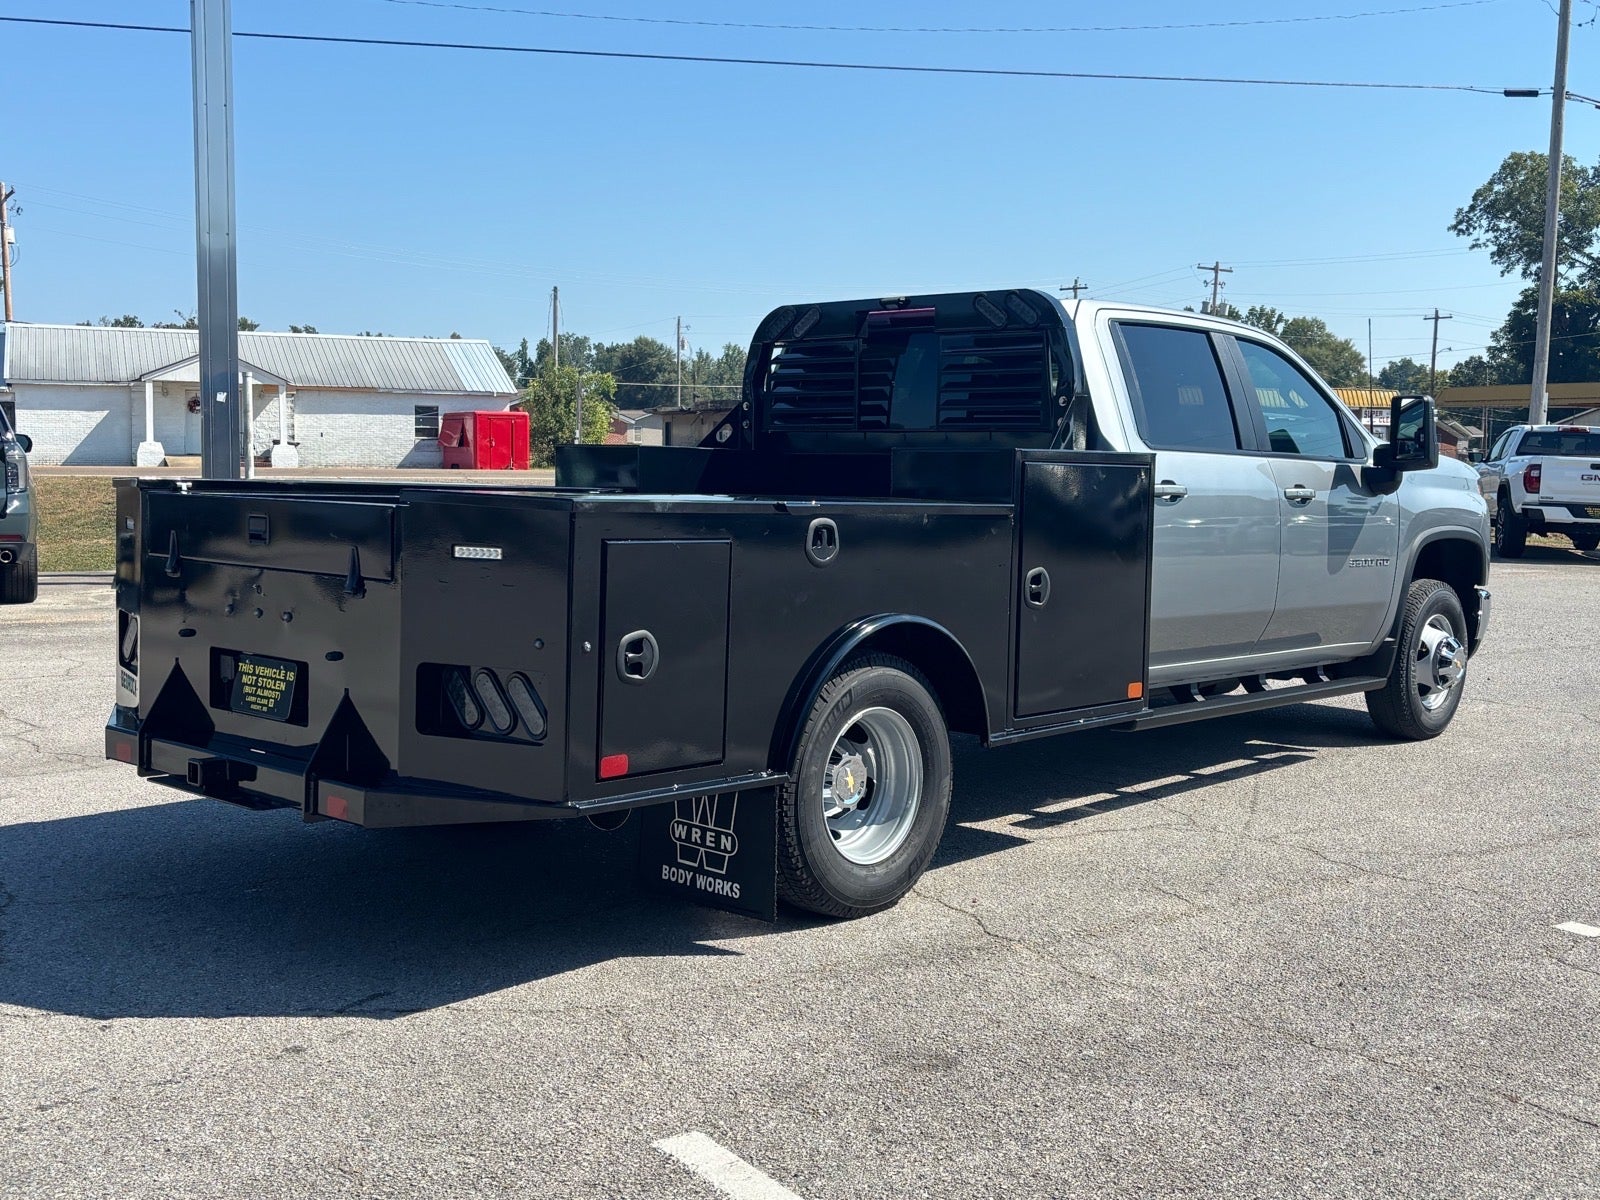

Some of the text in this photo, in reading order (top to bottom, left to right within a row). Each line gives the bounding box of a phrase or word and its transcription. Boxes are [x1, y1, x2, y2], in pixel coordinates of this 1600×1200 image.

[238, 663, 294, 681] THIS VEHICLE IS
[242, 674, 286, 691] NOT STOLEN
[243, 686, 281, 700] (BUT ALMOST)
[674, 822, 732, 851] WREN
[662, 864, 740, 899] BODY WORKS
